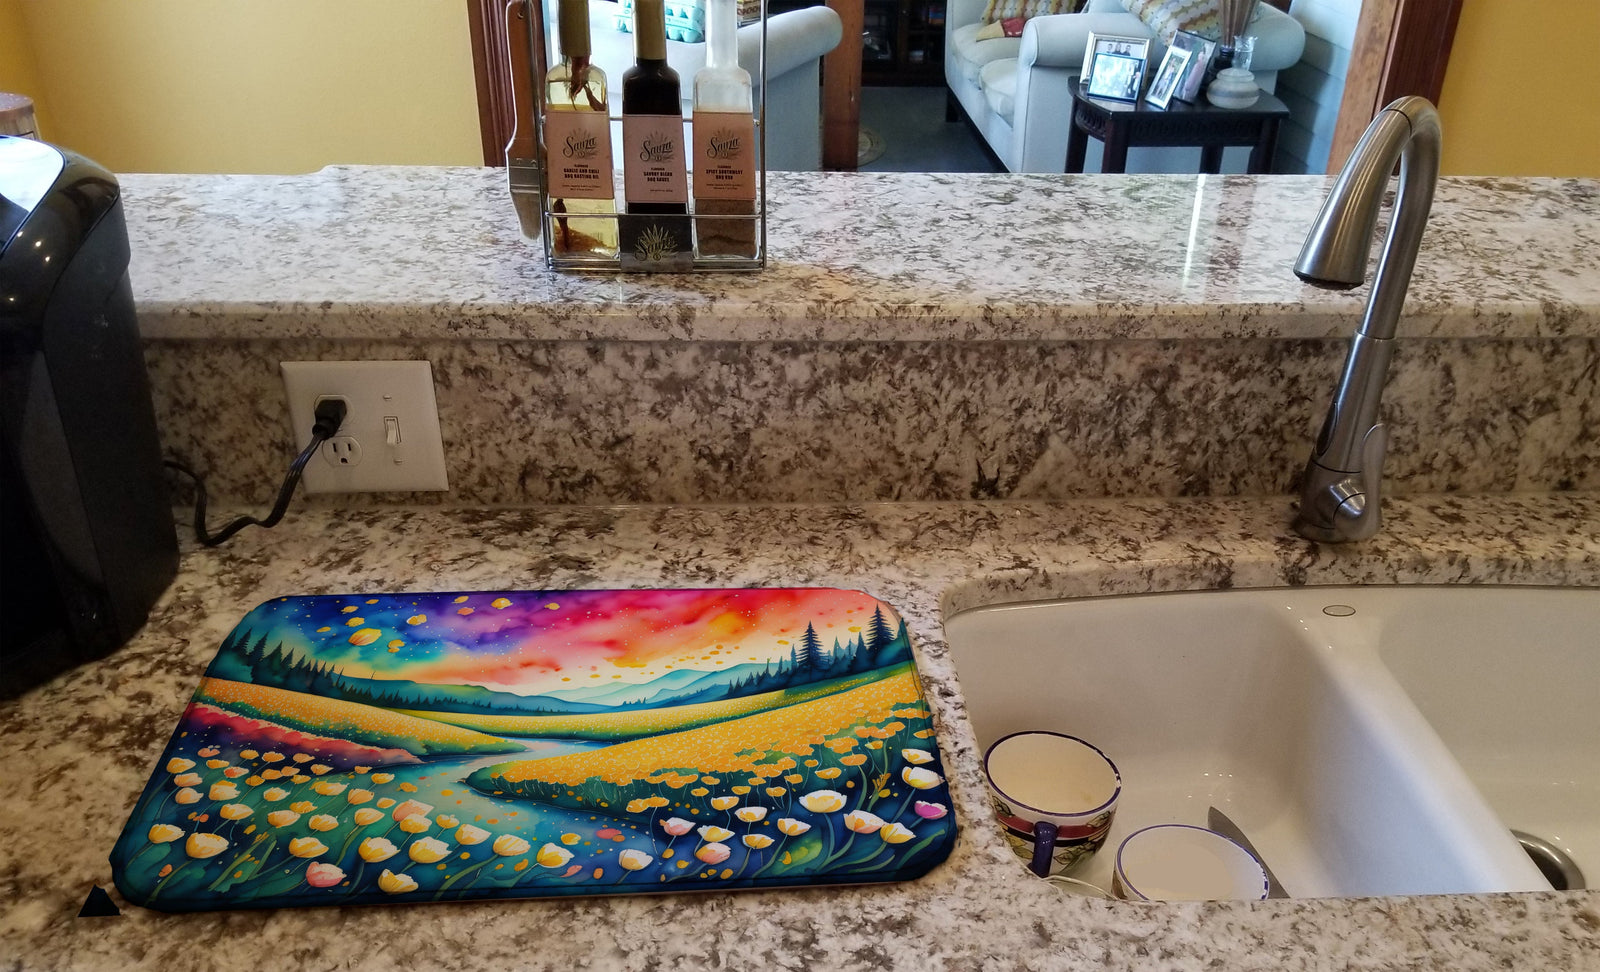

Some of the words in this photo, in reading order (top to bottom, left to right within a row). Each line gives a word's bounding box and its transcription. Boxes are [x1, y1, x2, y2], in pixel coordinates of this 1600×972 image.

[563, 136, 597, 158] Sauza
[640, 140, 673, 161] Sauza
[707, 136, 740, 159] Sauza
